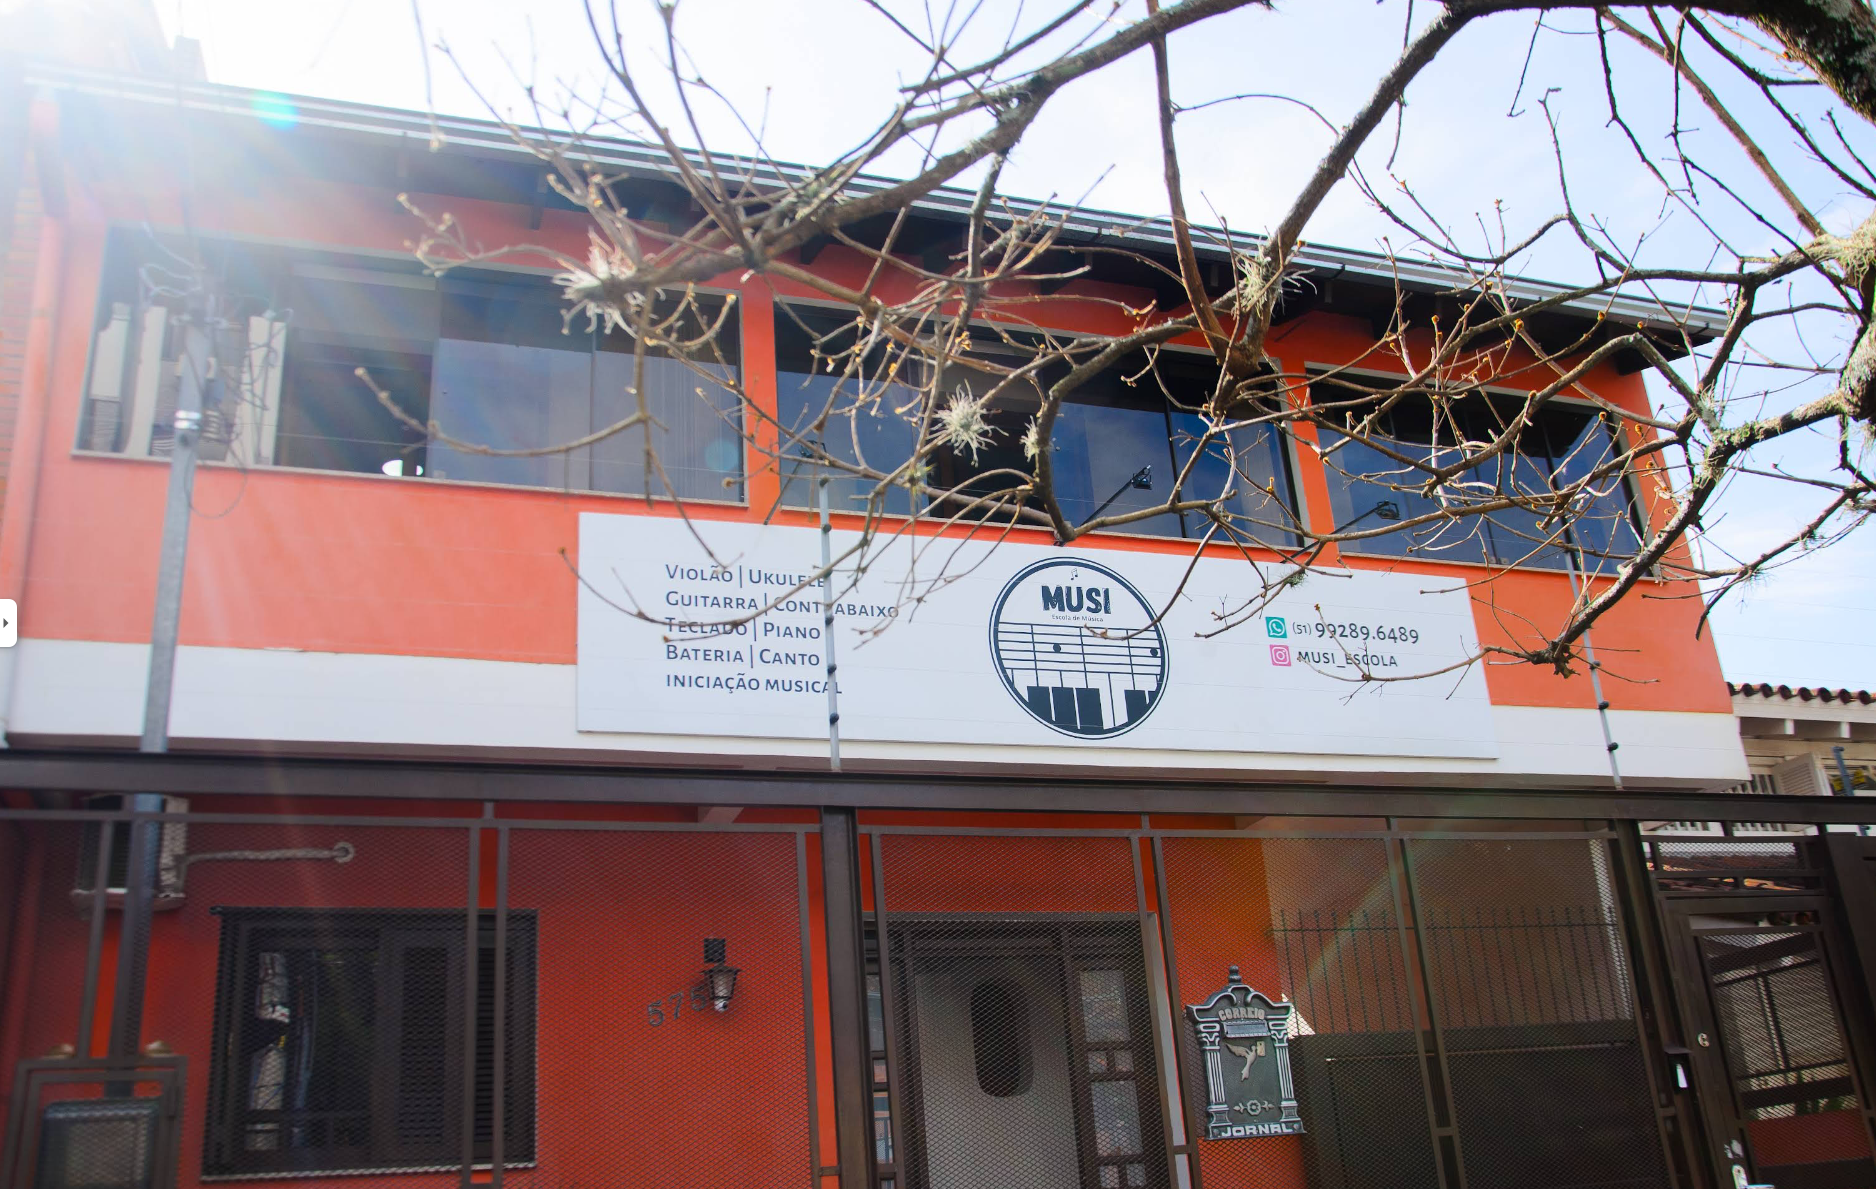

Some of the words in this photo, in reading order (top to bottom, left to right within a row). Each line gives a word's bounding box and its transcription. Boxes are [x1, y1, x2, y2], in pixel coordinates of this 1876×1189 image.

[666, 591, 759, 611] GUITARRA
[774, 597, 898, 618] CONTABAIXO
[1041, 585, 1111, 614] MUSI
[764, 622, 821, 639] PIANO
[1292, 622, 1312, 636] (51)
[1315, 623, 1419, 644] 99289.6489
[666, 644, 744, 663] BATERIA
[759, 649, 820, 666] CANTO
[666, 673, 760, 693] INICIAÇÃO
[1219, 1007, 1265, 1020] CORREIO
[1221, 1123, 1293, 1137] JORNAL
